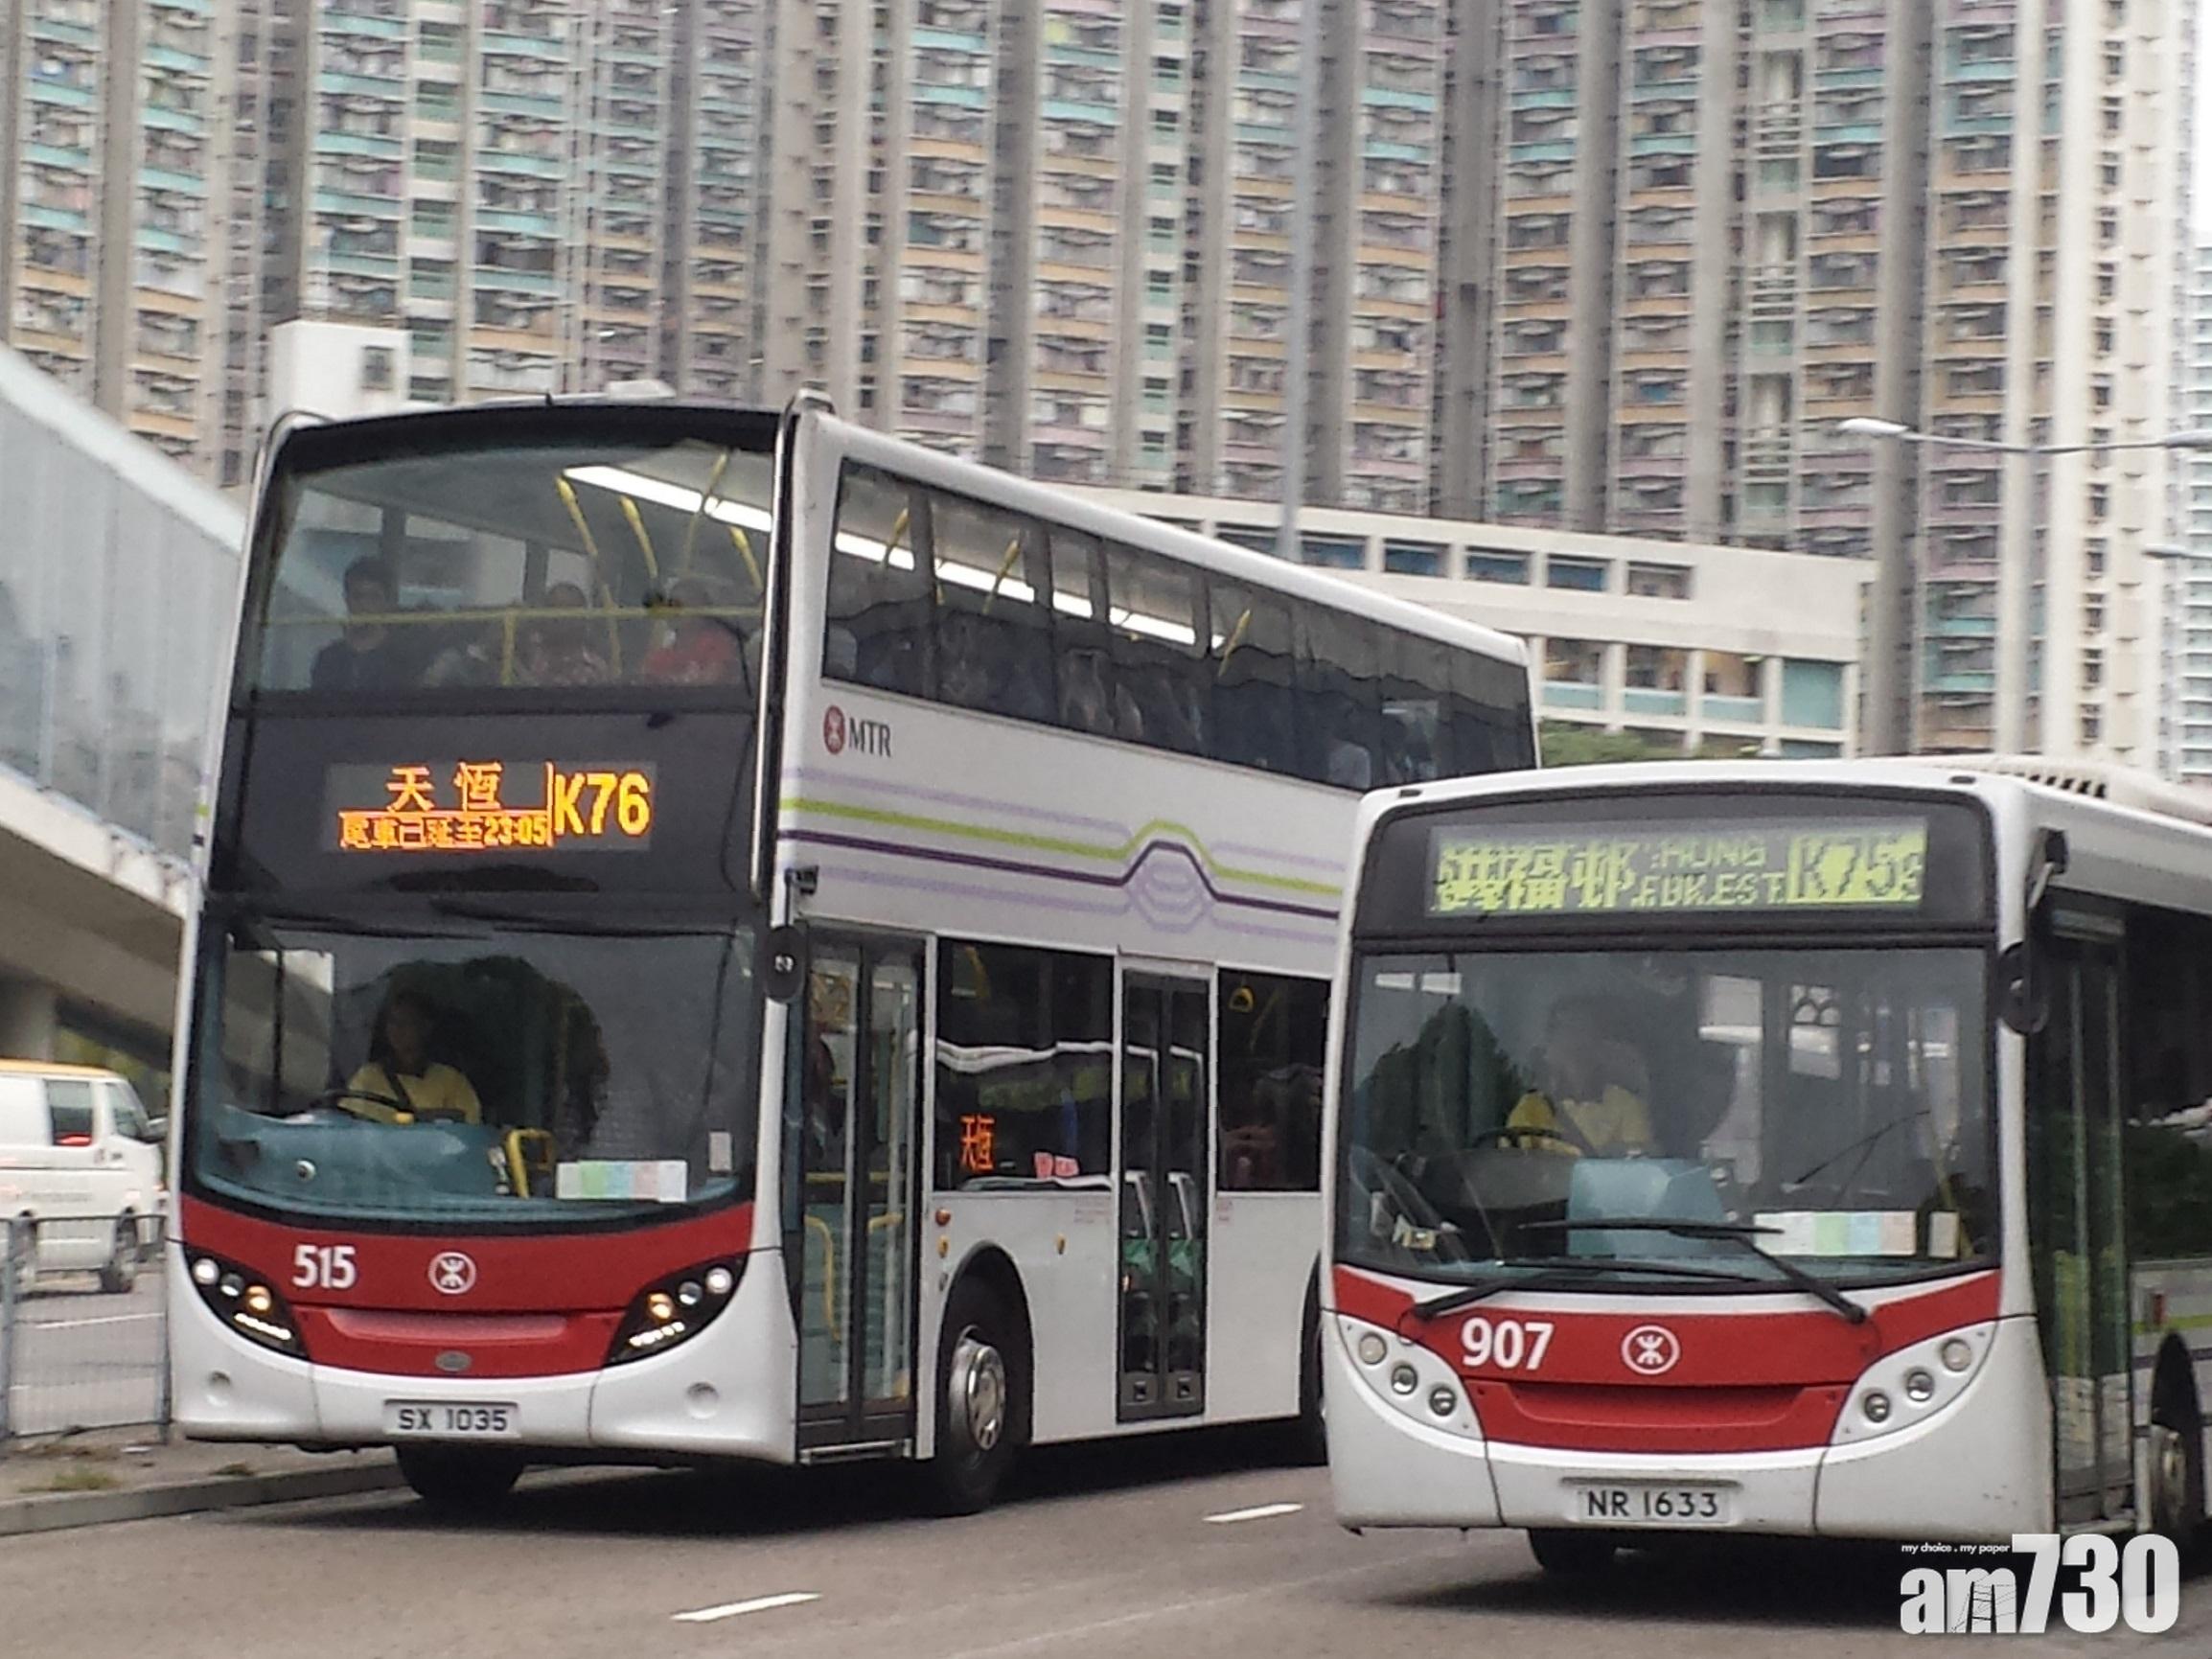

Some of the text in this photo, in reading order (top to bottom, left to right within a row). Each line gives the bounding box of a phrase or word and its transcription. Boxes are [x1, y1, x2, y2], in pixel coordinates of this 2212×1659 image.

[849, 717, 891, 757] MTR
[553, 772, 652, 837] K76
[293, 1243, 357, 1289] 515
[1461, 1319, 1554, 1371] 907
[399, 1408, 508, 1431] SX 1035
[1587, 1489, 1718, 1518] NR 1633
